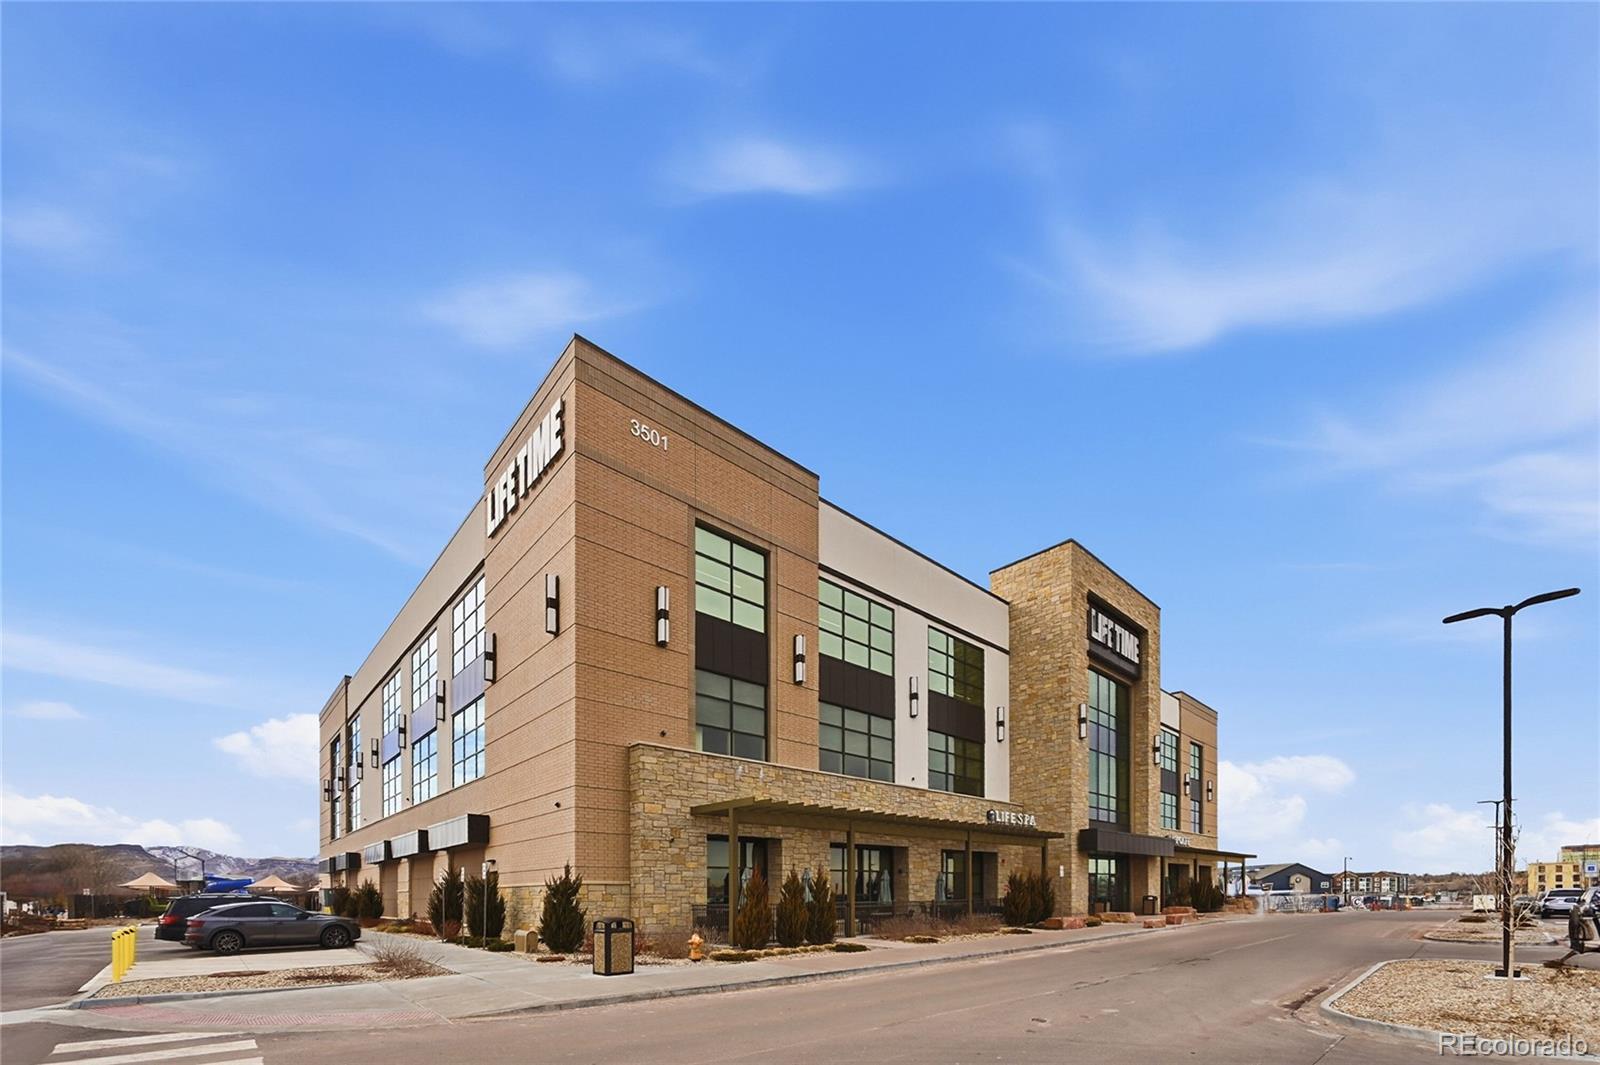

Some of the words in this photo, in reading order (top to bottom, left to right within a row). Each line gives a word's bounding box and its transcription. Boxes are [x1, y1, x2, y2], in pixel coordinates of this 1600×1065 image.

[487, 458, 518, 537] LIFE
[517, 397, 563, 498] TIME
[630, 419, 669, 451] 3501
